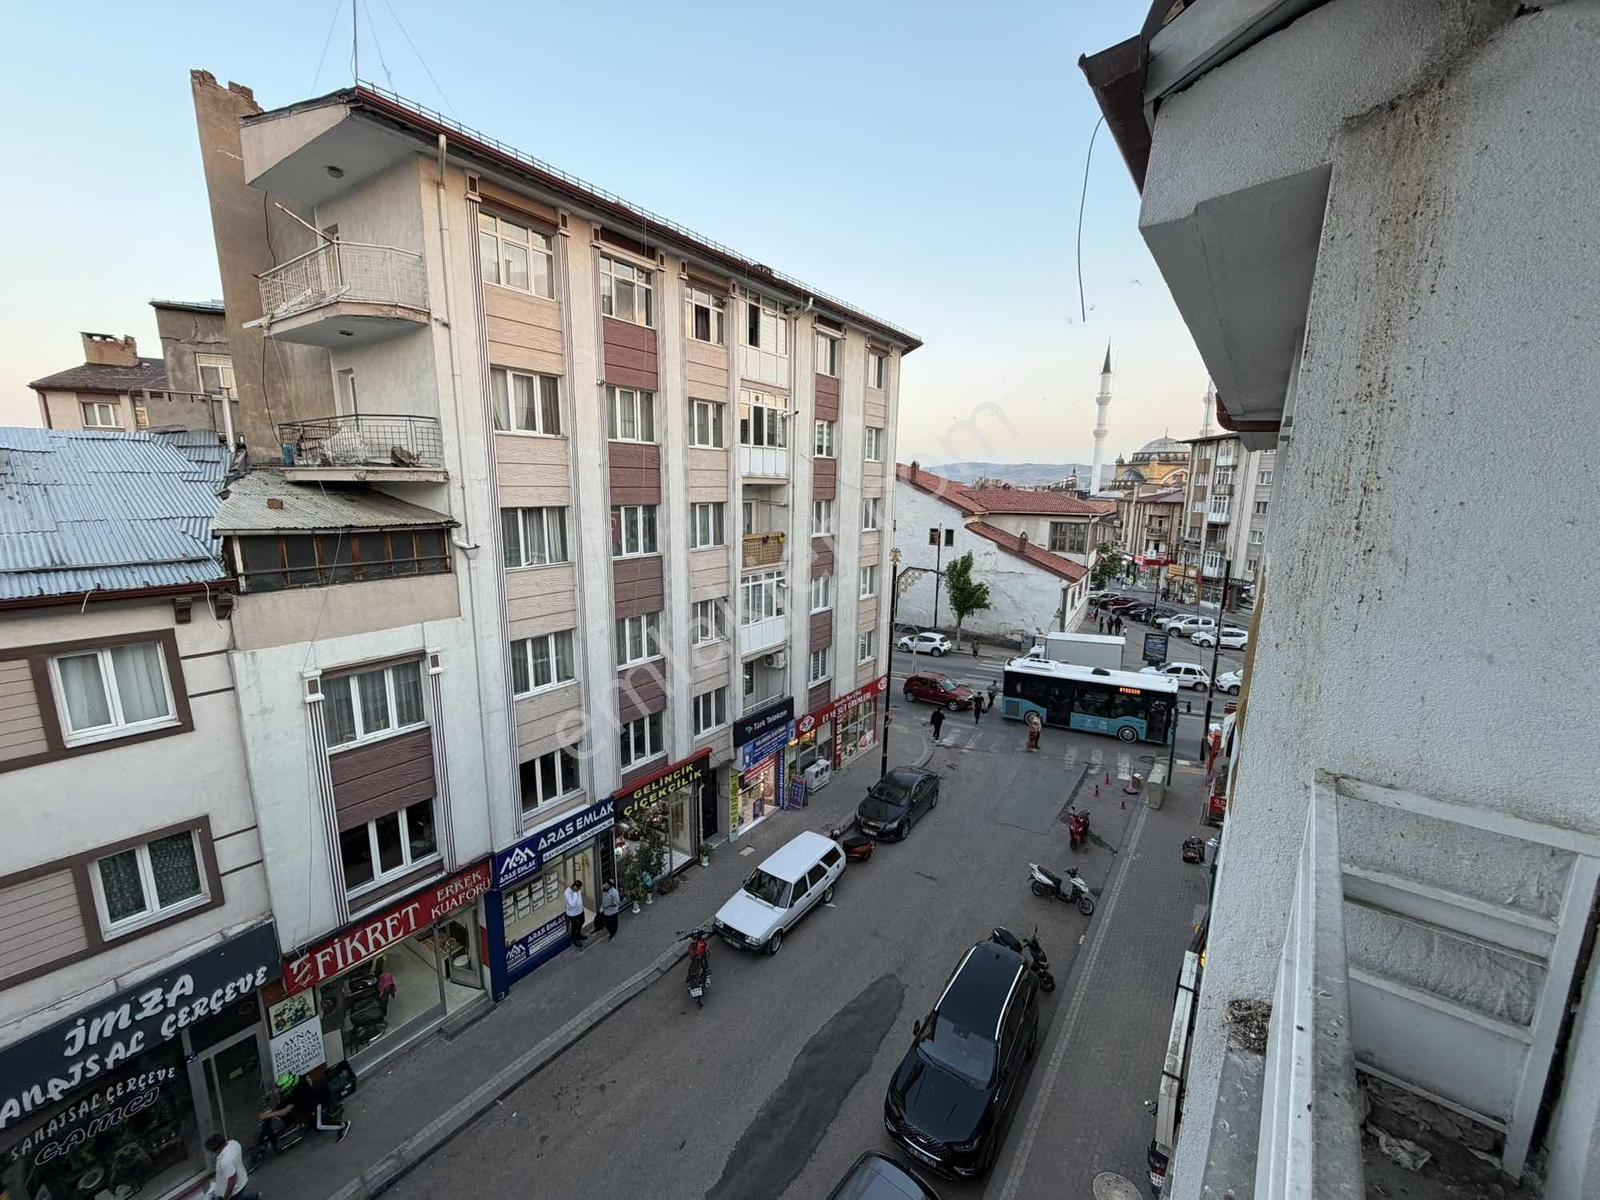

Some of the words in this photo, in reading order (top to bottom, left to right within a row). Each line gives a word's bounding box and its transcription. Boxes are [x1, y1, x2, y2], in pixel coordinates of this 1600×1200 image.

[623, 769, 702, 817] ÇİÇEKÇİLİK
[537, 821, 575, 851] ARAS
[576, 801, 615, 831] EMLAK
[437, 870, 482, 902] ERKEK
[499, 867, 517, 883] ARAS
[517, 860, 537, 874] EMLAK
[313, 901, 421, 982] FİKRET
[528, 926, 546, 943] ARAS
[0, 1031, 146, 1129] ANATSAL
[160, 965, 268, 1042] ÇERÇEVE
[11, 1094, 101, 1162] SANATSAL
[106, 1066, 177, 1105] ÇERÇEVE
